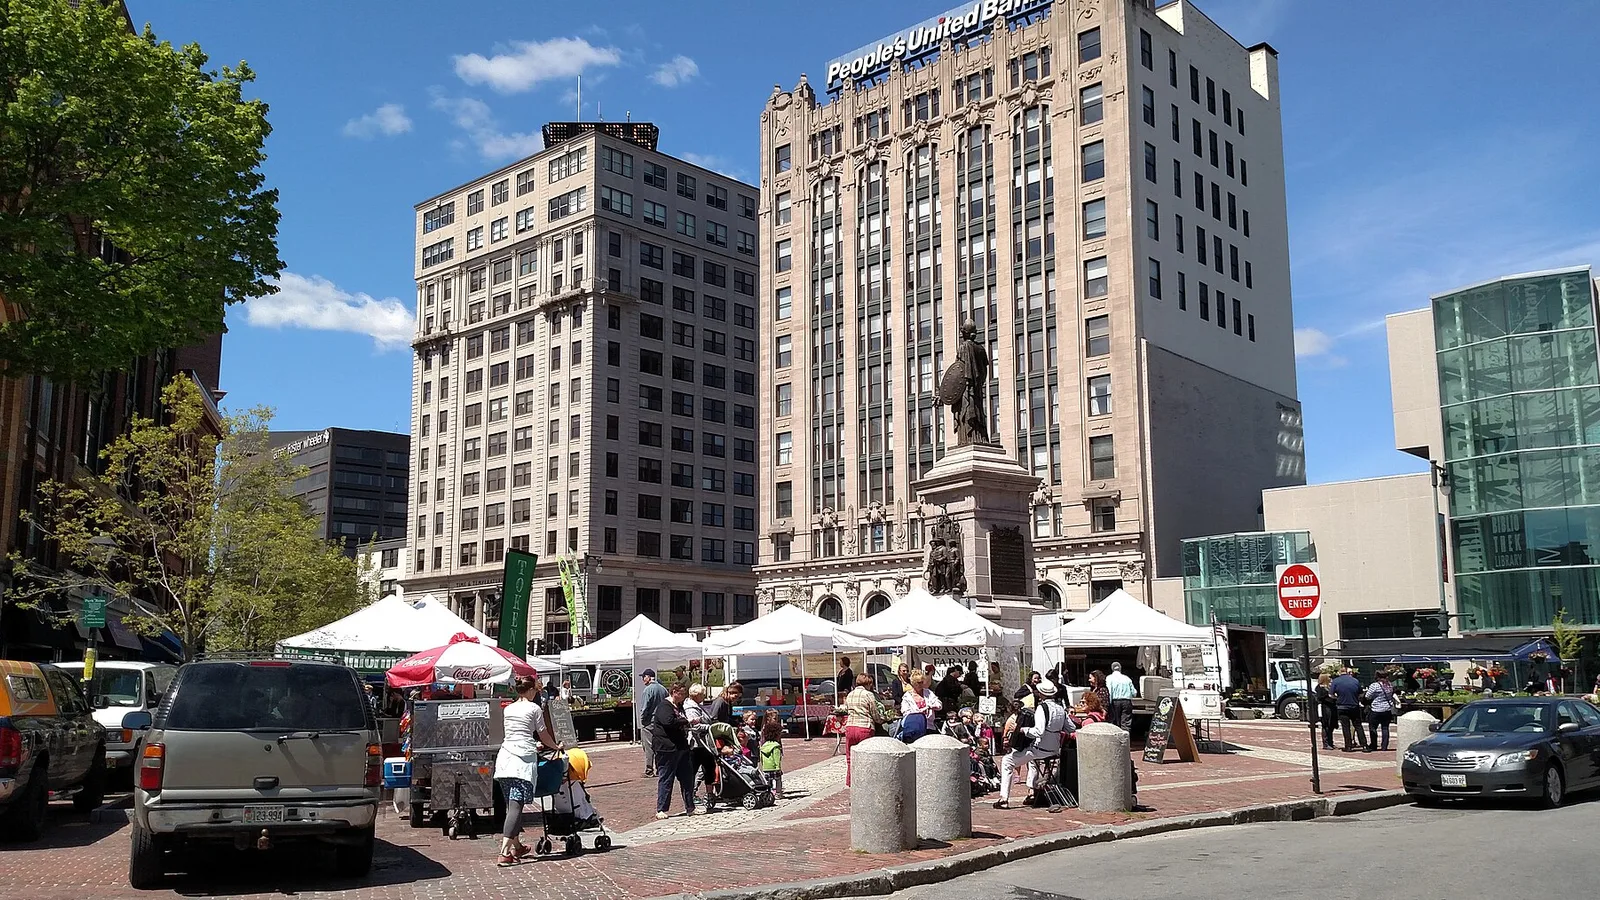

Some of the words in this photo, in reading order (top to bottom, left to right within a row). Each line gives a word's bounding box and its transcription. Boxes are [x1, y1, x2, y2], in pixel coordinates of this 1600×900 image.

[827, 35, 906, 85] People's
[907, 2, 980, 50] United
[980, 0, 1041, 22] Ban
[303, 432, 324, 449] wheeler
[1493, 534, 1522, 553] THEK
[1494, 553, 1523, 568] LIBRARY
[1283, 575, 1295, 585] DO
[1298, 574, 1314, 584] NOT
[1288, 599, 1313, 609] ENTER
[915, 646, 980, 656] GORANSO
[933, 658, 969, 668] FARM
